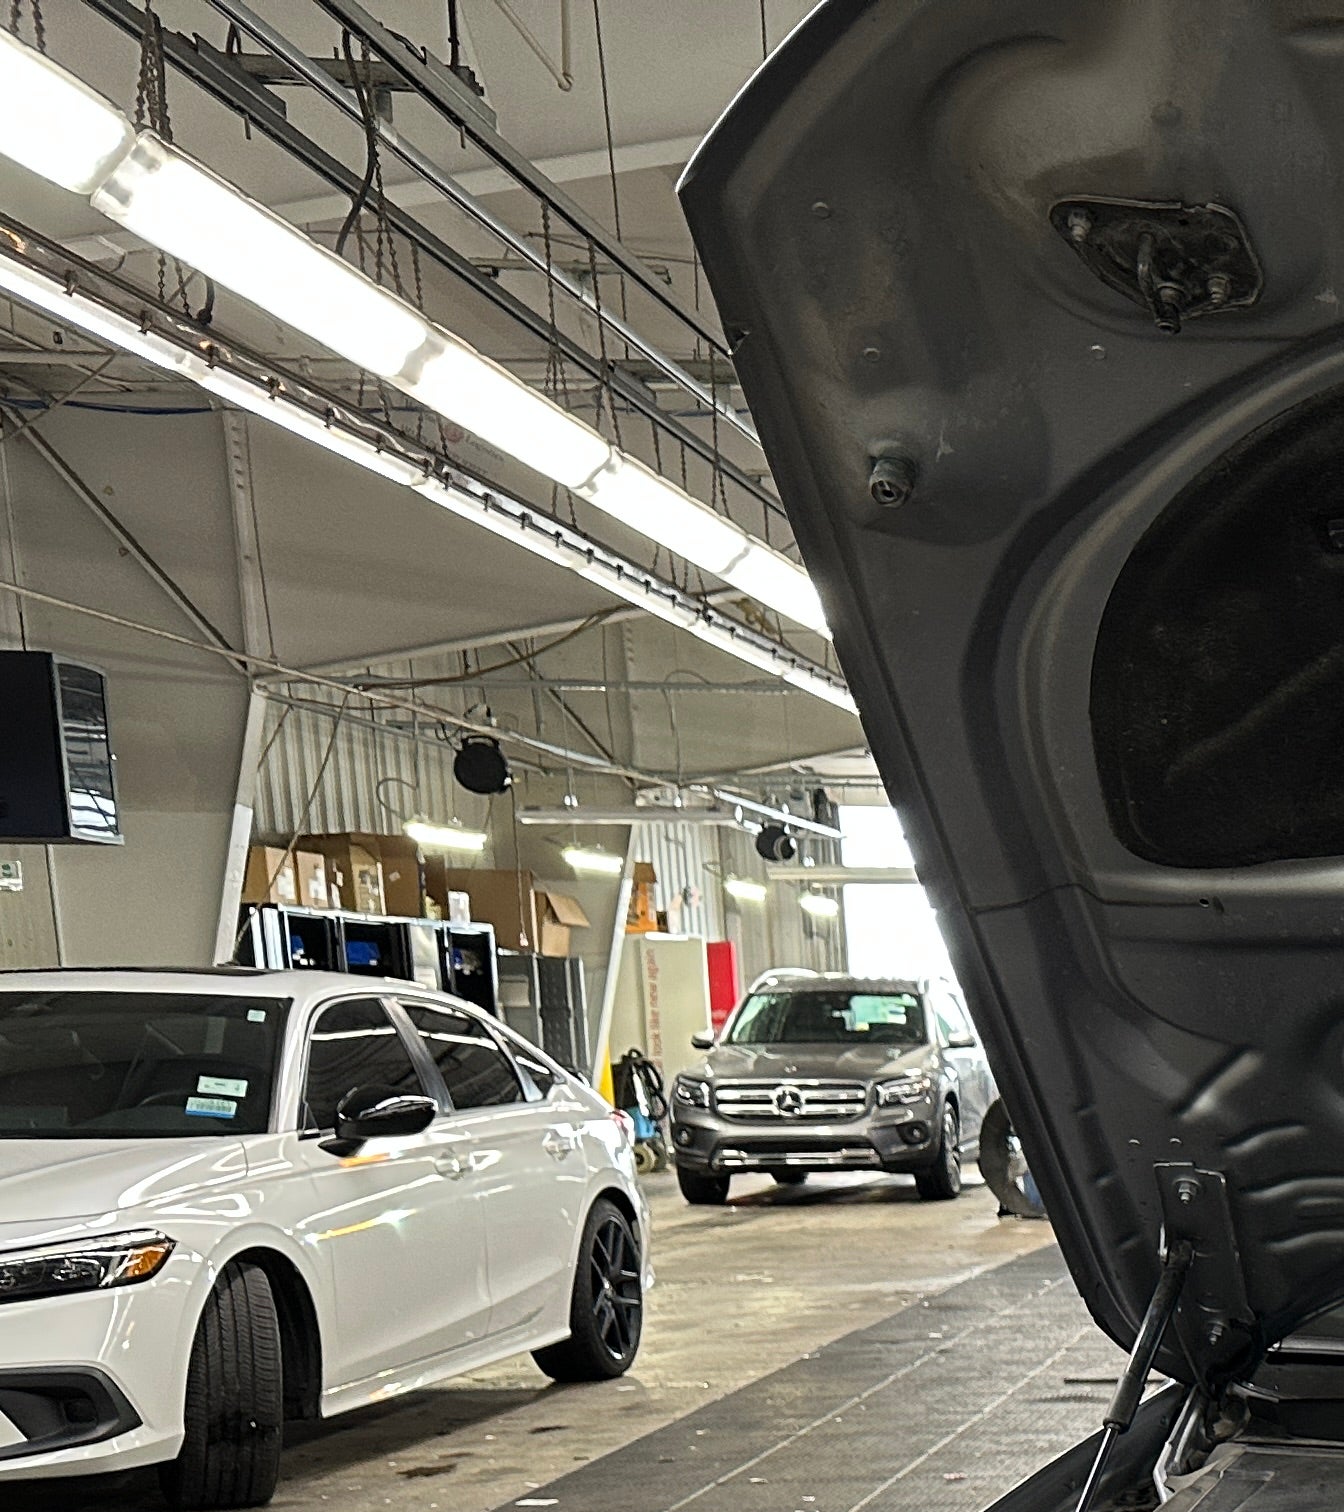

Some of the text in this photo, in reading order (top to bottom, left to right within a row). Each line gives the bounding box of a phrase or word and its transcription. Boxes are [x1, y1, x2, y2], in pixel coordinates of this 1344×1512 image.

[646, 948, 659, 981] again
[649, 982, 658, 1008] new
[649, 1009, 659, 1030] like
